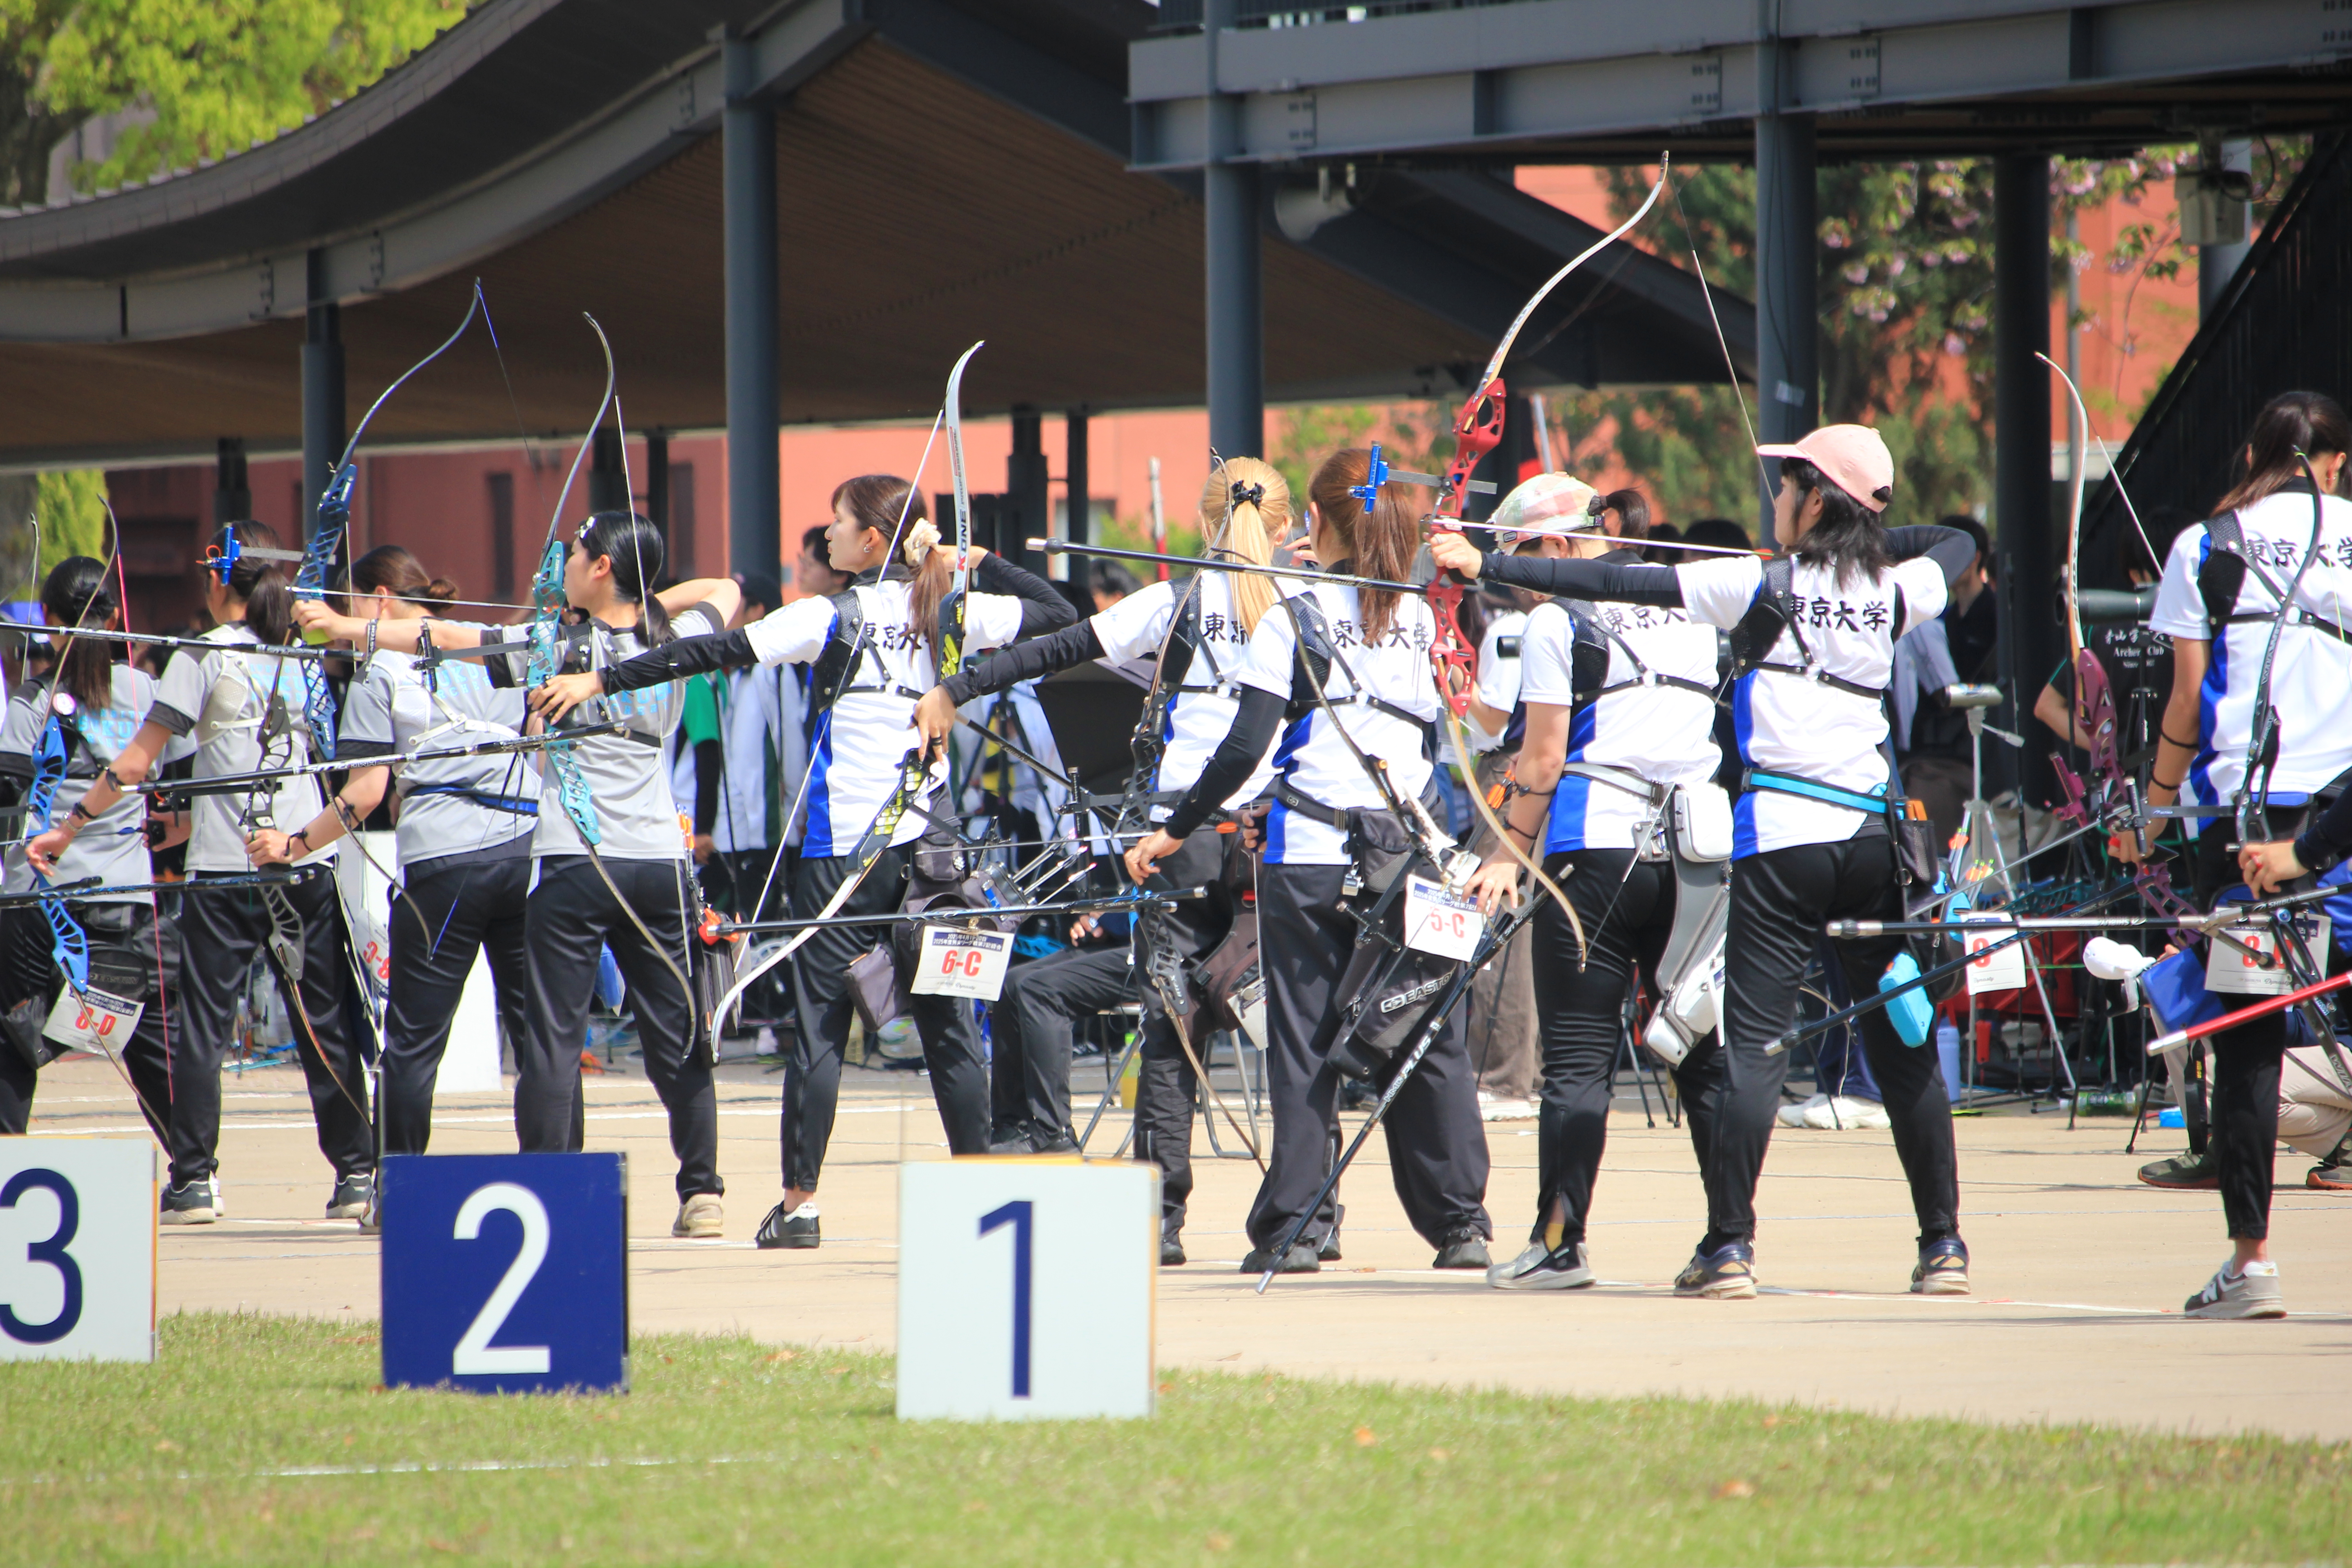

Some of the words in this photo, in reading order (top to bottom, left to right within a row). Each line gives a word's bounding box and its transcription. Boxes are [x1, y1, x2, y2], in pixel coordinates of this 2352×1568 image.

[957, 552, 967, 572] K
[2146, 645, 2165, 656] Club
[1430, 906, 1465, 939] 5-C
[941, 949, 982, 977] 6-C
[1405, 972, 1453, 1005] EASTO
[75, 1007, 117, 1036] 8-D
[1403, 1035, 1432, 1079] PLUS
[0, 1168, 82, 1345] 3
[453, 1183, 551, 1375] 2
[979, 1200, 1034, 1399] 1
